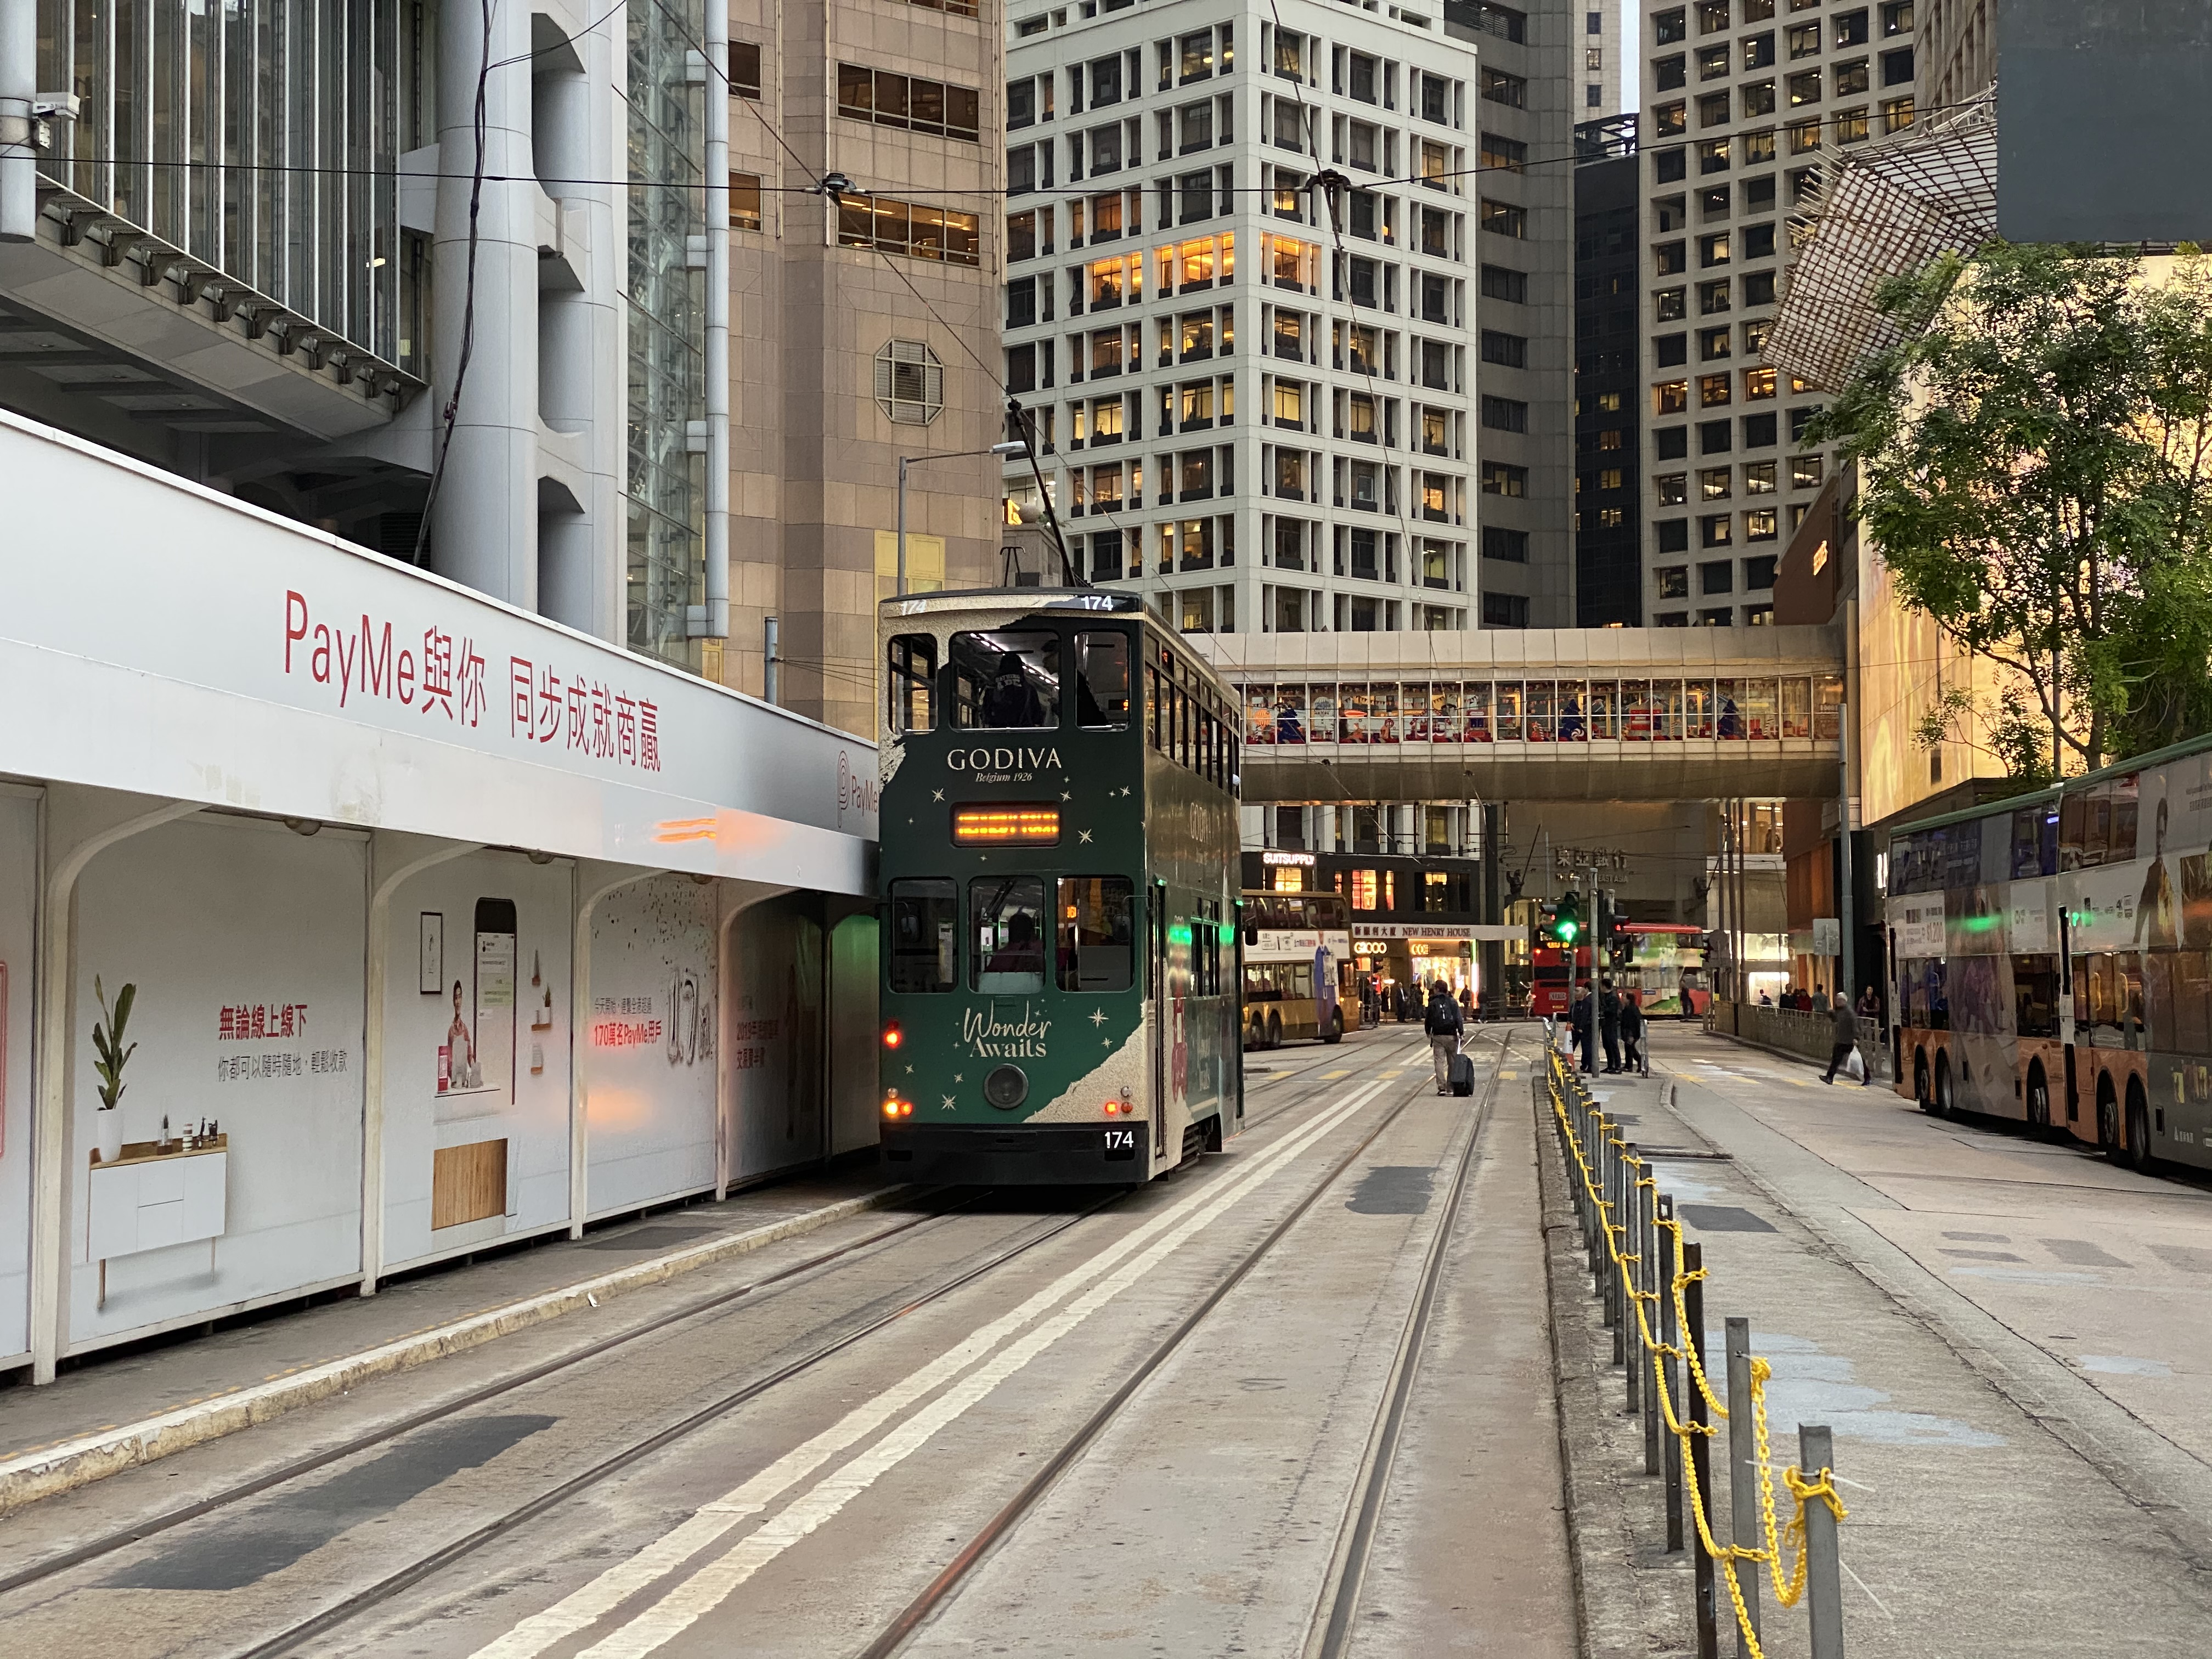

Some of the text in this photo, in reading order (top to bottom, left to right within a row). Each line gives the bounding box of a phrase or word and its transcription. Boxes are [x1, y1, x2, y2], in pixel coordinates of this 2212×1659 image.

[901, 599, 926, 616] 174
[1081, 595, 1113, 611] 174
[285, 590, 661, 772] PayMe與你 同步成就商贏
[947, 748, 1062, 770] GODIVA
[975, 772, 1032, 783] Belgium 1926
[851, 775, 878, 817] PayMe
[1263, 853, 1314, 865] SUITSUPPLY
[1402, 927, 1419, 936] NEW
[1421, 927, 1445, 937] HENRY
[1447, 928, 1471, 937] HOUSE
[218, 1003, 308, 1041] 無論線上線下
[964, 1000, 1052, 1043] Wonder
[969, 1036, 1047, 1058] Awaits
[1104, 1131, 1134, 1149] 174
